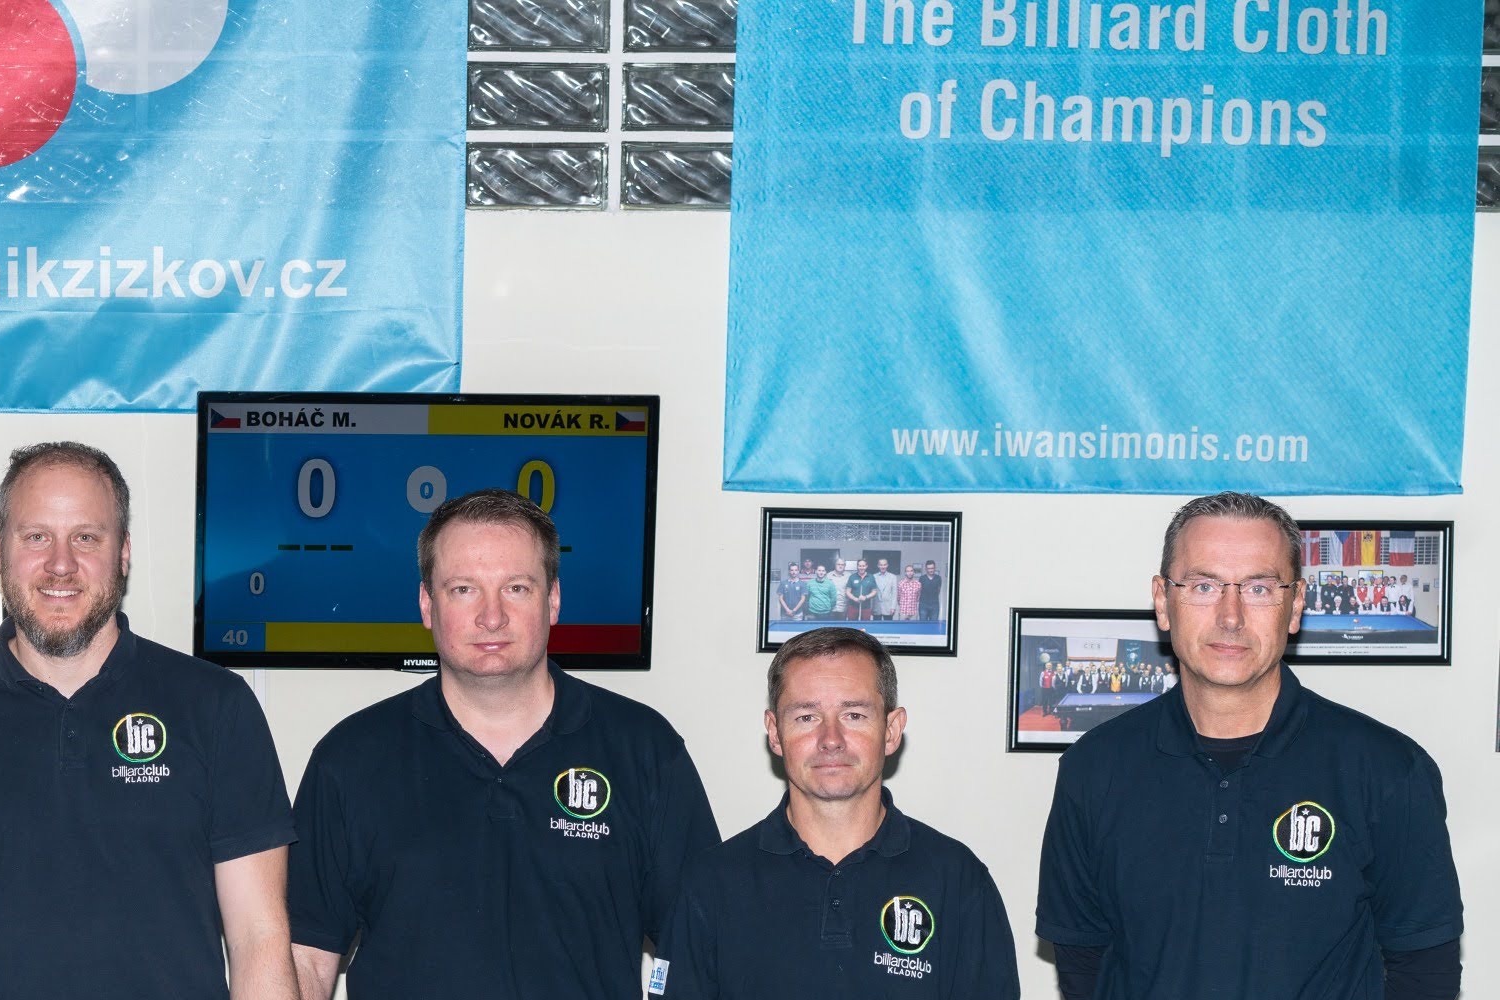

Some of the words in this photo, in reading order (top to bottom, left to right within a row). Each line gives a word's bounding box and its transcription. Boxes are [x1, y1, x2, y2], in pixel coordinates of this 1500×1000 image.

[850, 0, 954, 46] The
[981, 0, 1206, 51] Billiard
[1232, 0, 1389, 56] Cloth
[900, 79, 958, 141] of
[981, 79, 1328, 158] Champions
[245, 407, 325, 428] BOHÁČ
[331, 410, 357, 428] M.
[502, 409, 582, 430] NOVÁK
[588, 413, 610, 430] R.
[892, 423, 1309, 464] www.iwansimonis.com
[297, 458, 336, 518] 0
[517, 460, 556, 514] 0
[248, 571, 265, 595] 0
[221, 629, 249, 646] 40
[111, 764, 171, 778] billiardclub
[125, 776, 160, 784] KLADNO
[550, 817, 610, 836] billiardclub
[563, 829, 600, 840] KLADNO
[1269, 864, 1332, 880] billiardclub
[1284, 878, 1321, 888] KLADNO
[873, 951, 932, 974] billiardclub
[887, 966, 923, 979] KLADNO
